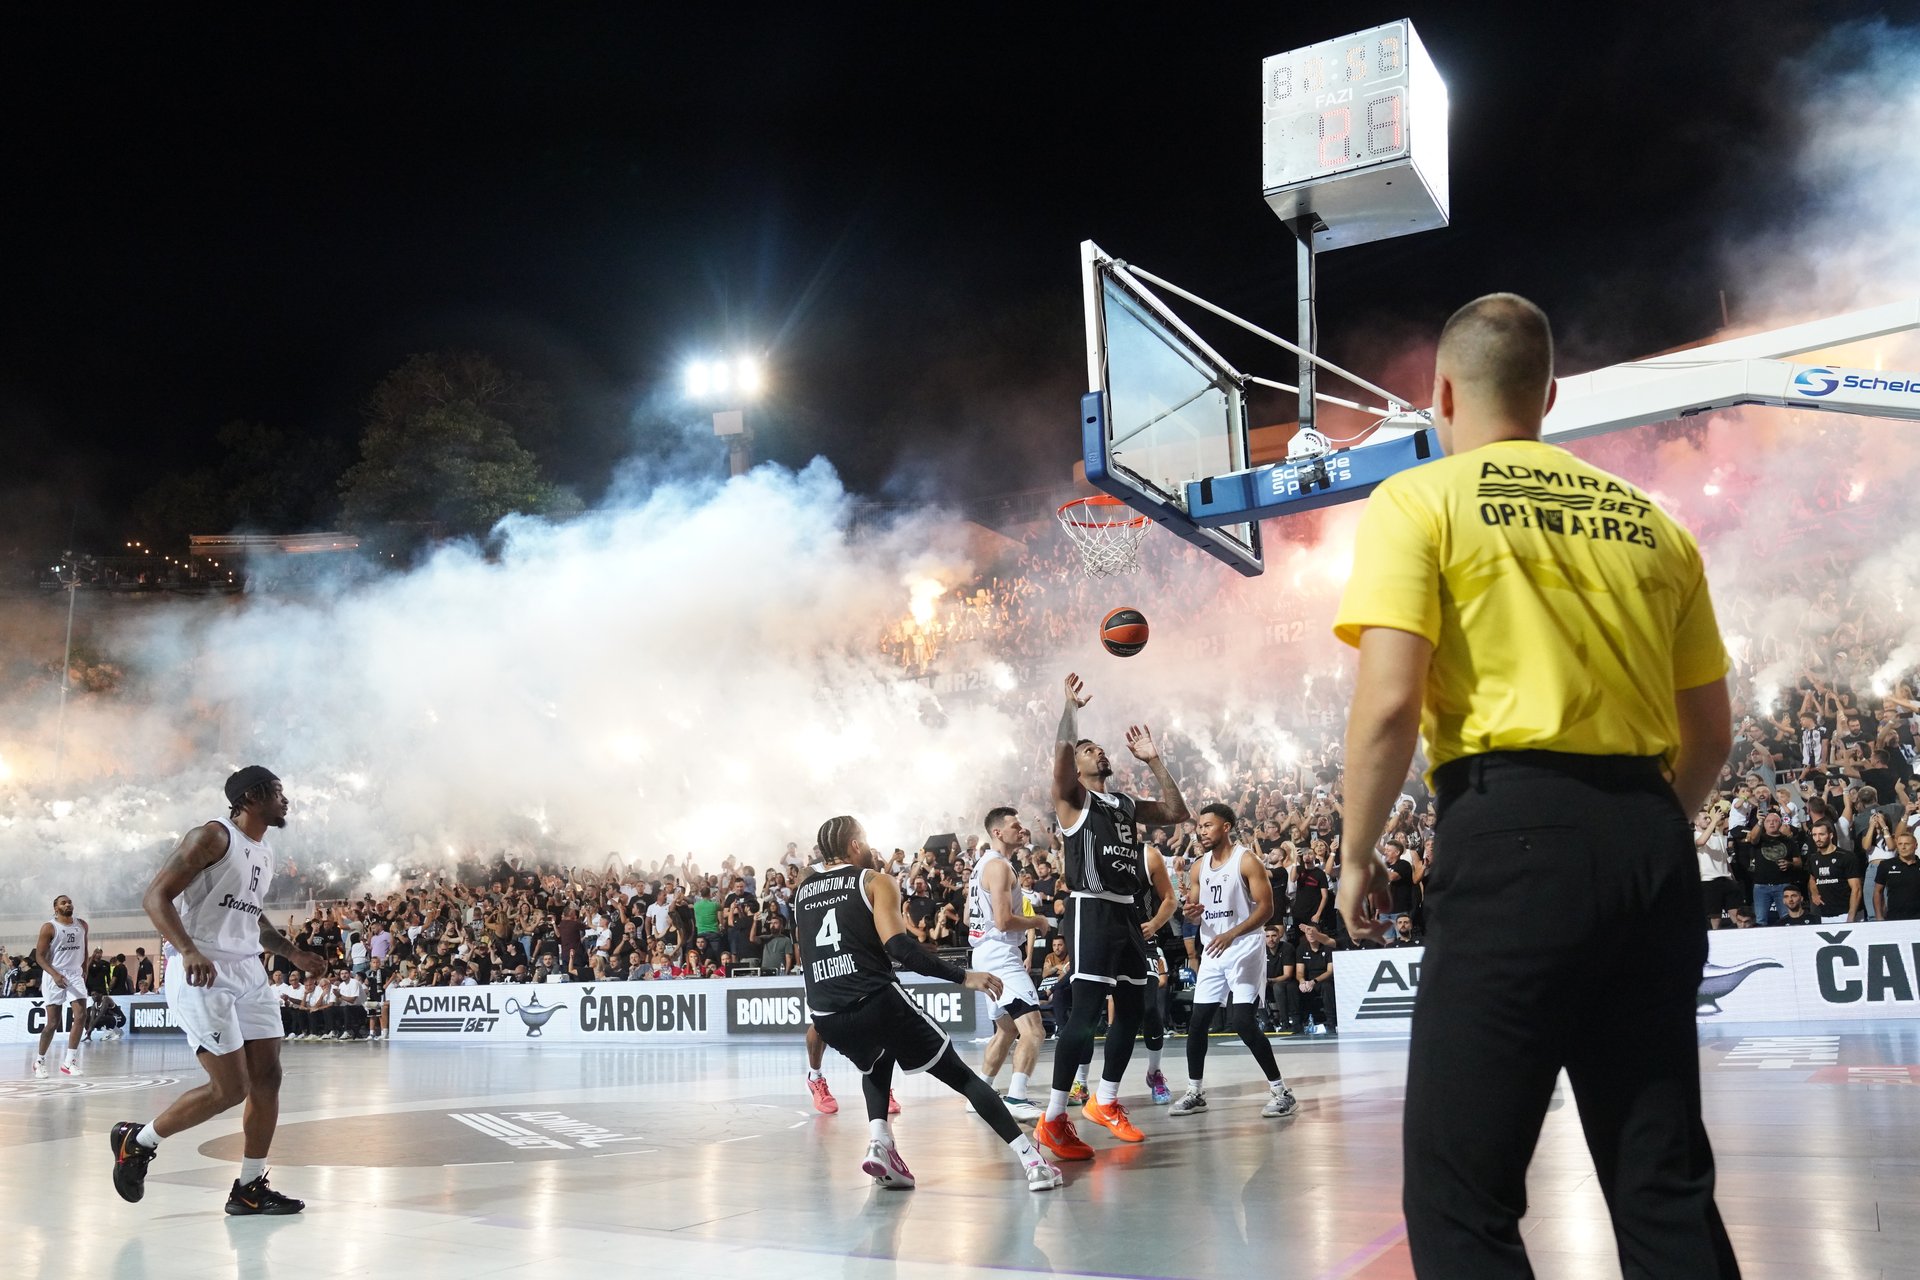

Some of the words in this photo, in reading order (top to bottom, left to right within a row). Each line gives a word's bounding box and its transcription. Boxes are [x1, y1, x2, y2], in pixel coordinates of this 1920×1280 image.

[1316, 87, 1354, 109] FAZI
[1481, 462, 1651, 505] ADMIRAL
[1598, 498, 1652, 519] BET
[1114, 822, 1133, 845] 12
[248, 864, 261, 893] 16
[804, 894, 848, 911] CHANGAN
[1210, 885, 1223, 904] 22
[66, 932, 76, 944] 26
[815, 907, 842, 953] 4
[811, 953, 859, 984] BELGRADE
[402, 992, 500, 1015] ADMIRAL
[579, 986, 707, 1033] ČAROBNI
[736, 996, 801, 1026] BONUS
[134, 1008, 165, 1028] BONUS
[462, 1017, 499, 1033] BET
